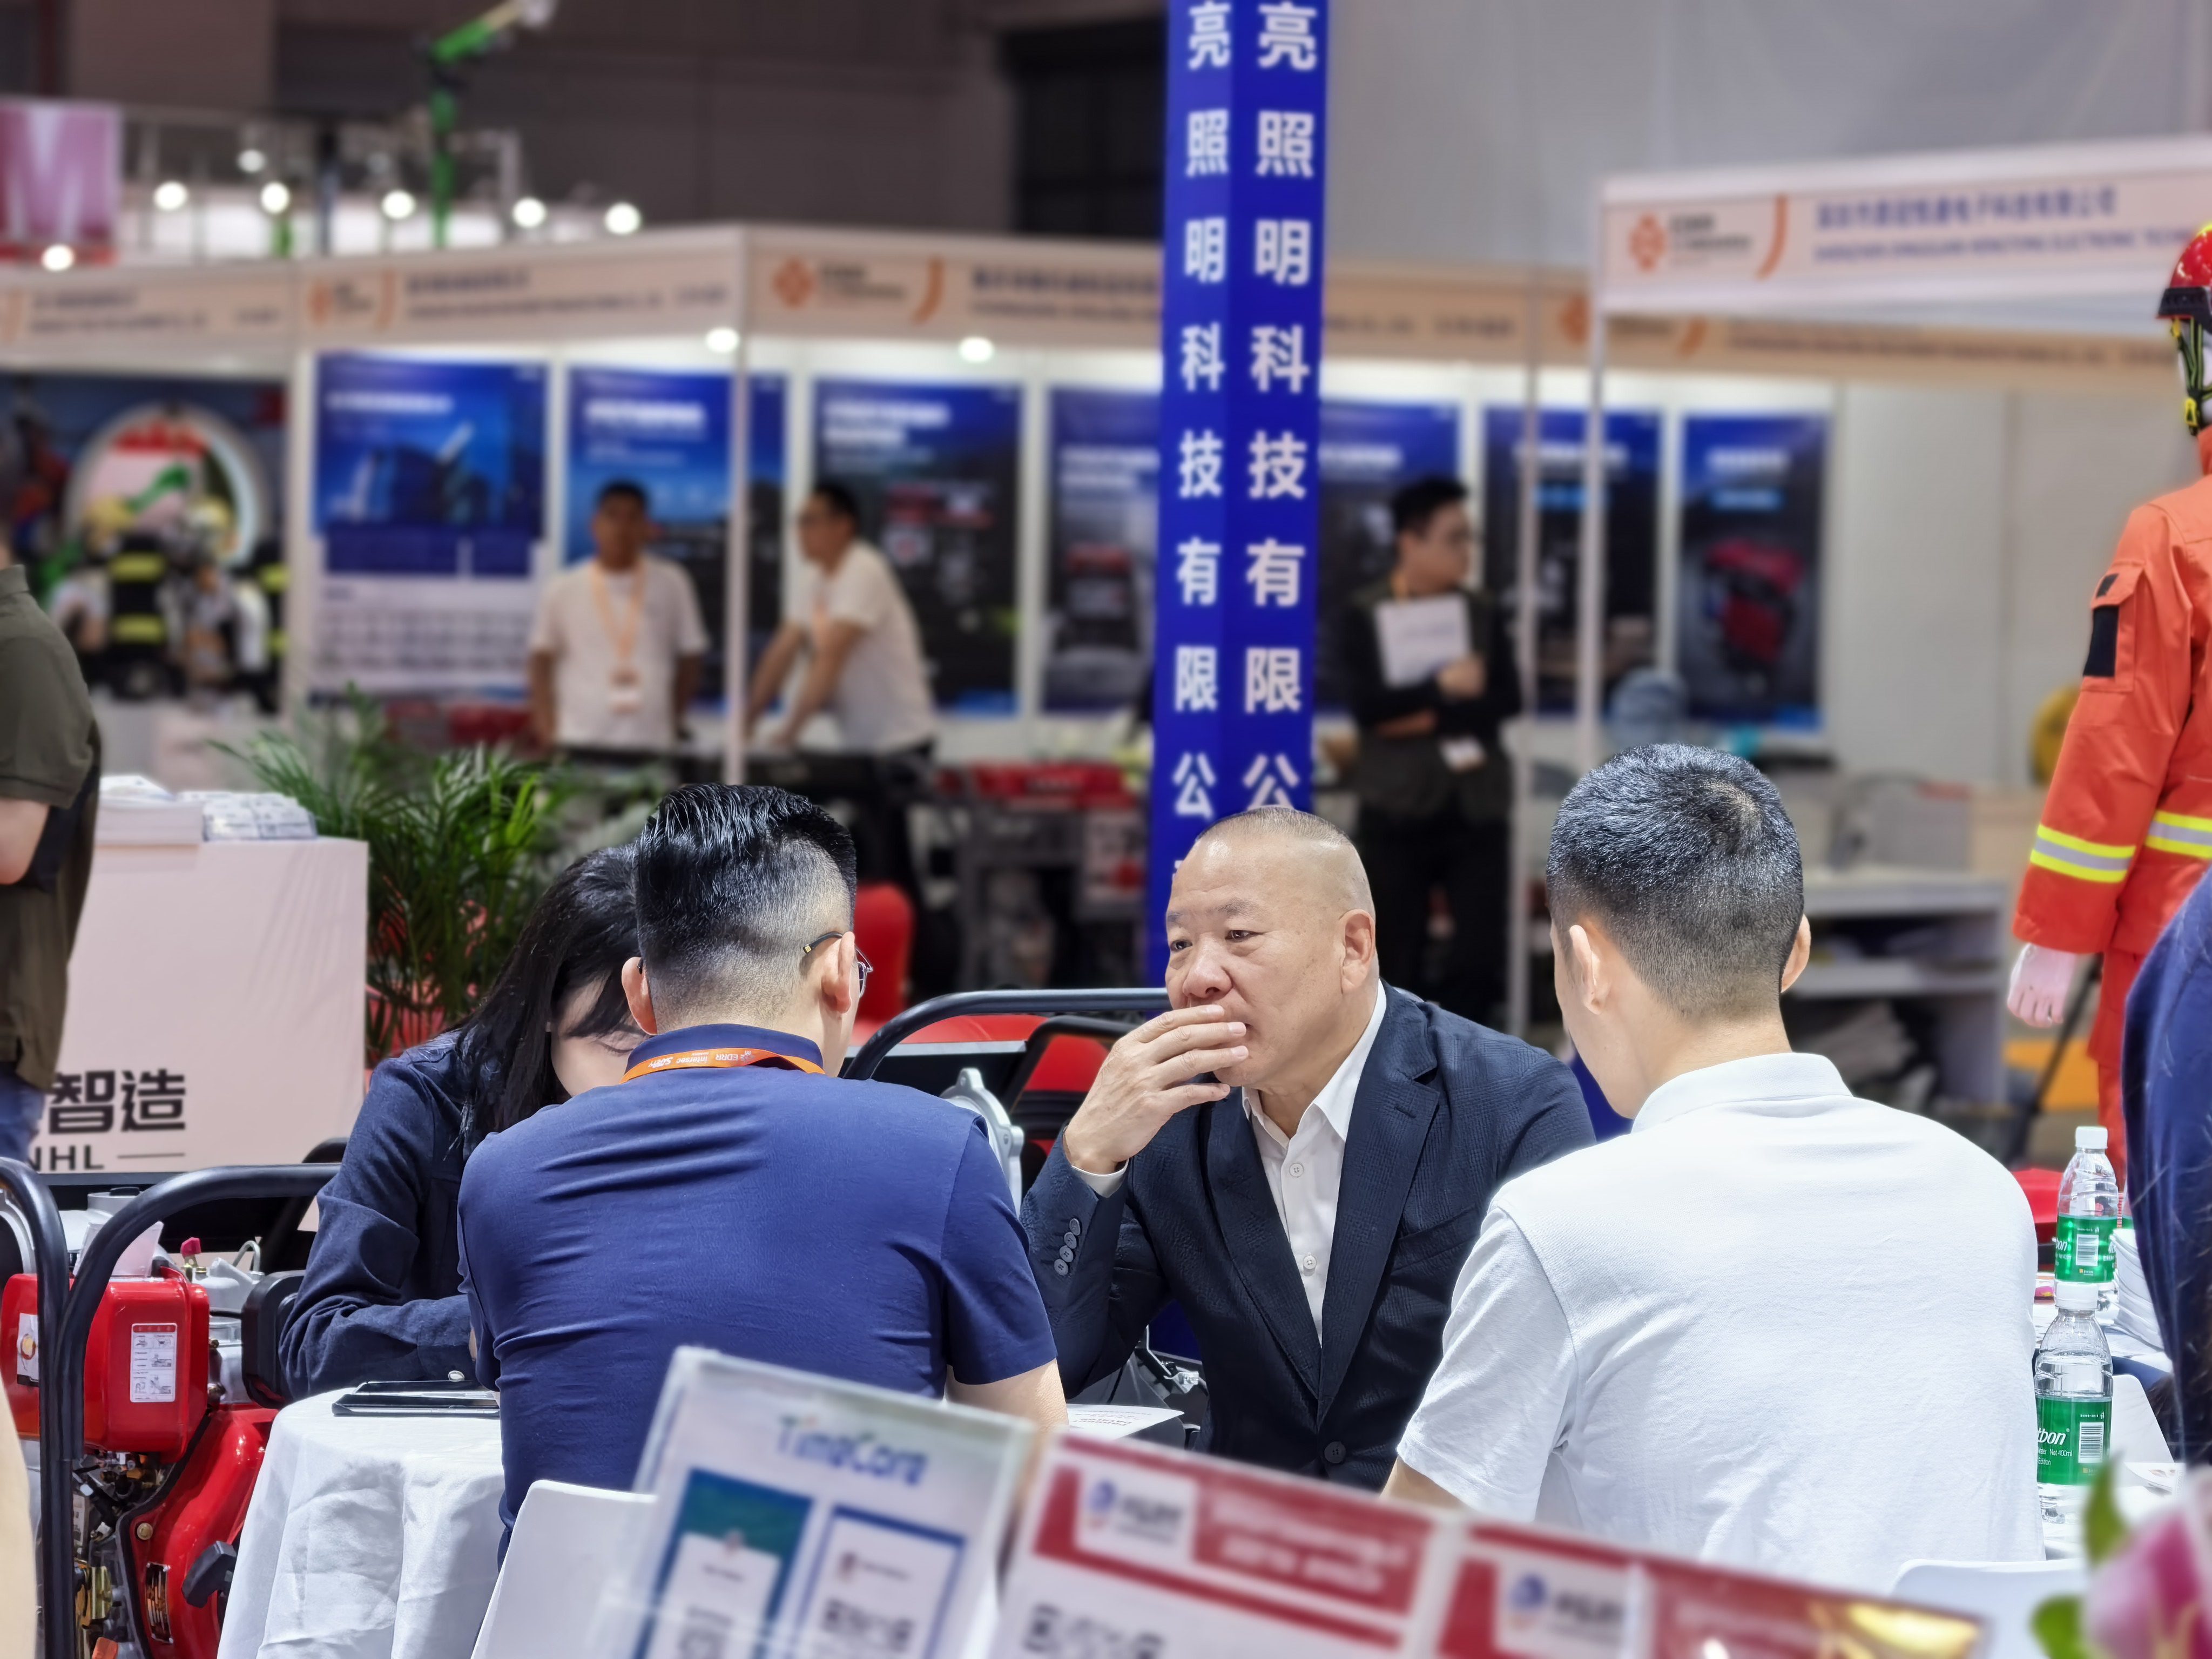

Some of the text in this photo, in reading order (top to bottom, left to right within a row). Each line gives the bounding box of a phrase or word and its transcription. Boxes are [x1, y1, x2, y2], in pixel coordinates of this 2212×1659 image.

[1172, 1, 1231, 881] 亮照明科技有限公
[1243, 1, 1317, 811] 亮照明科技有限公
[49, 1068, 186, 1135] 智造
[676, 1056, 708, 1064] intersec
